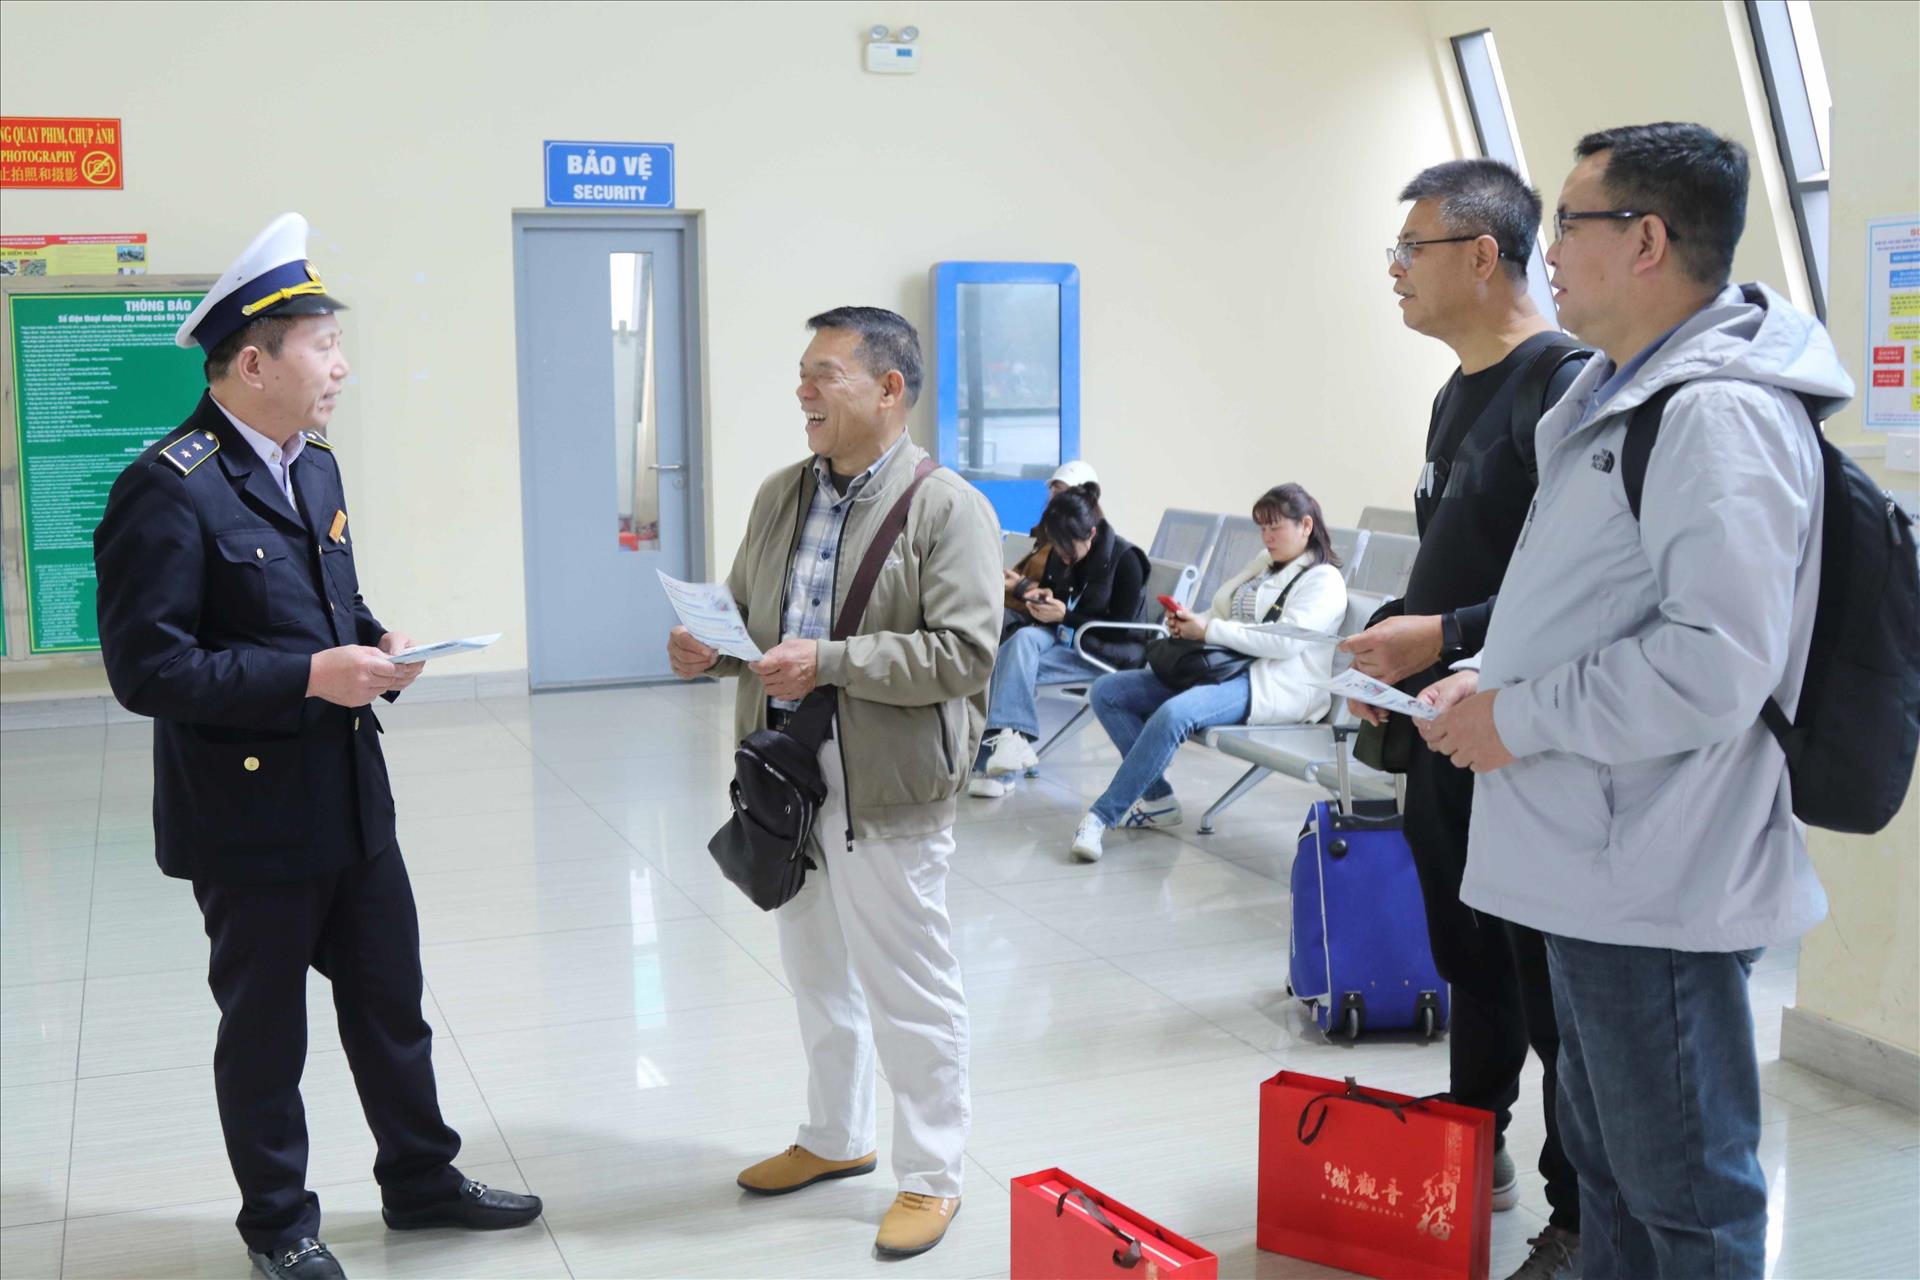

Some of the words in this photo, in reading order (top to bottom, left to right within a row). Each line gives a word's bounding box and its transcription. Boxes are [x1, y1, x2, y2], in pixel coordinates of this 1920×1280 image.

[13, 127, 39, 147] QUAY
[41, 127, 68, 147] PHIM,
[68, 128, 94, 149] CHỤP
[96, 123, 115, 145] ẢNH
[1, 150, 76, 163] PHOTOGRAPHY
[567, 148, 617, 176] BẢO
[623, 152, 653, 181] VỆ
[573, 184, 647, 201] SECURITY
[125, 298, 164, 313] THÔNG
[167, 297, 192, 312] BÁO
